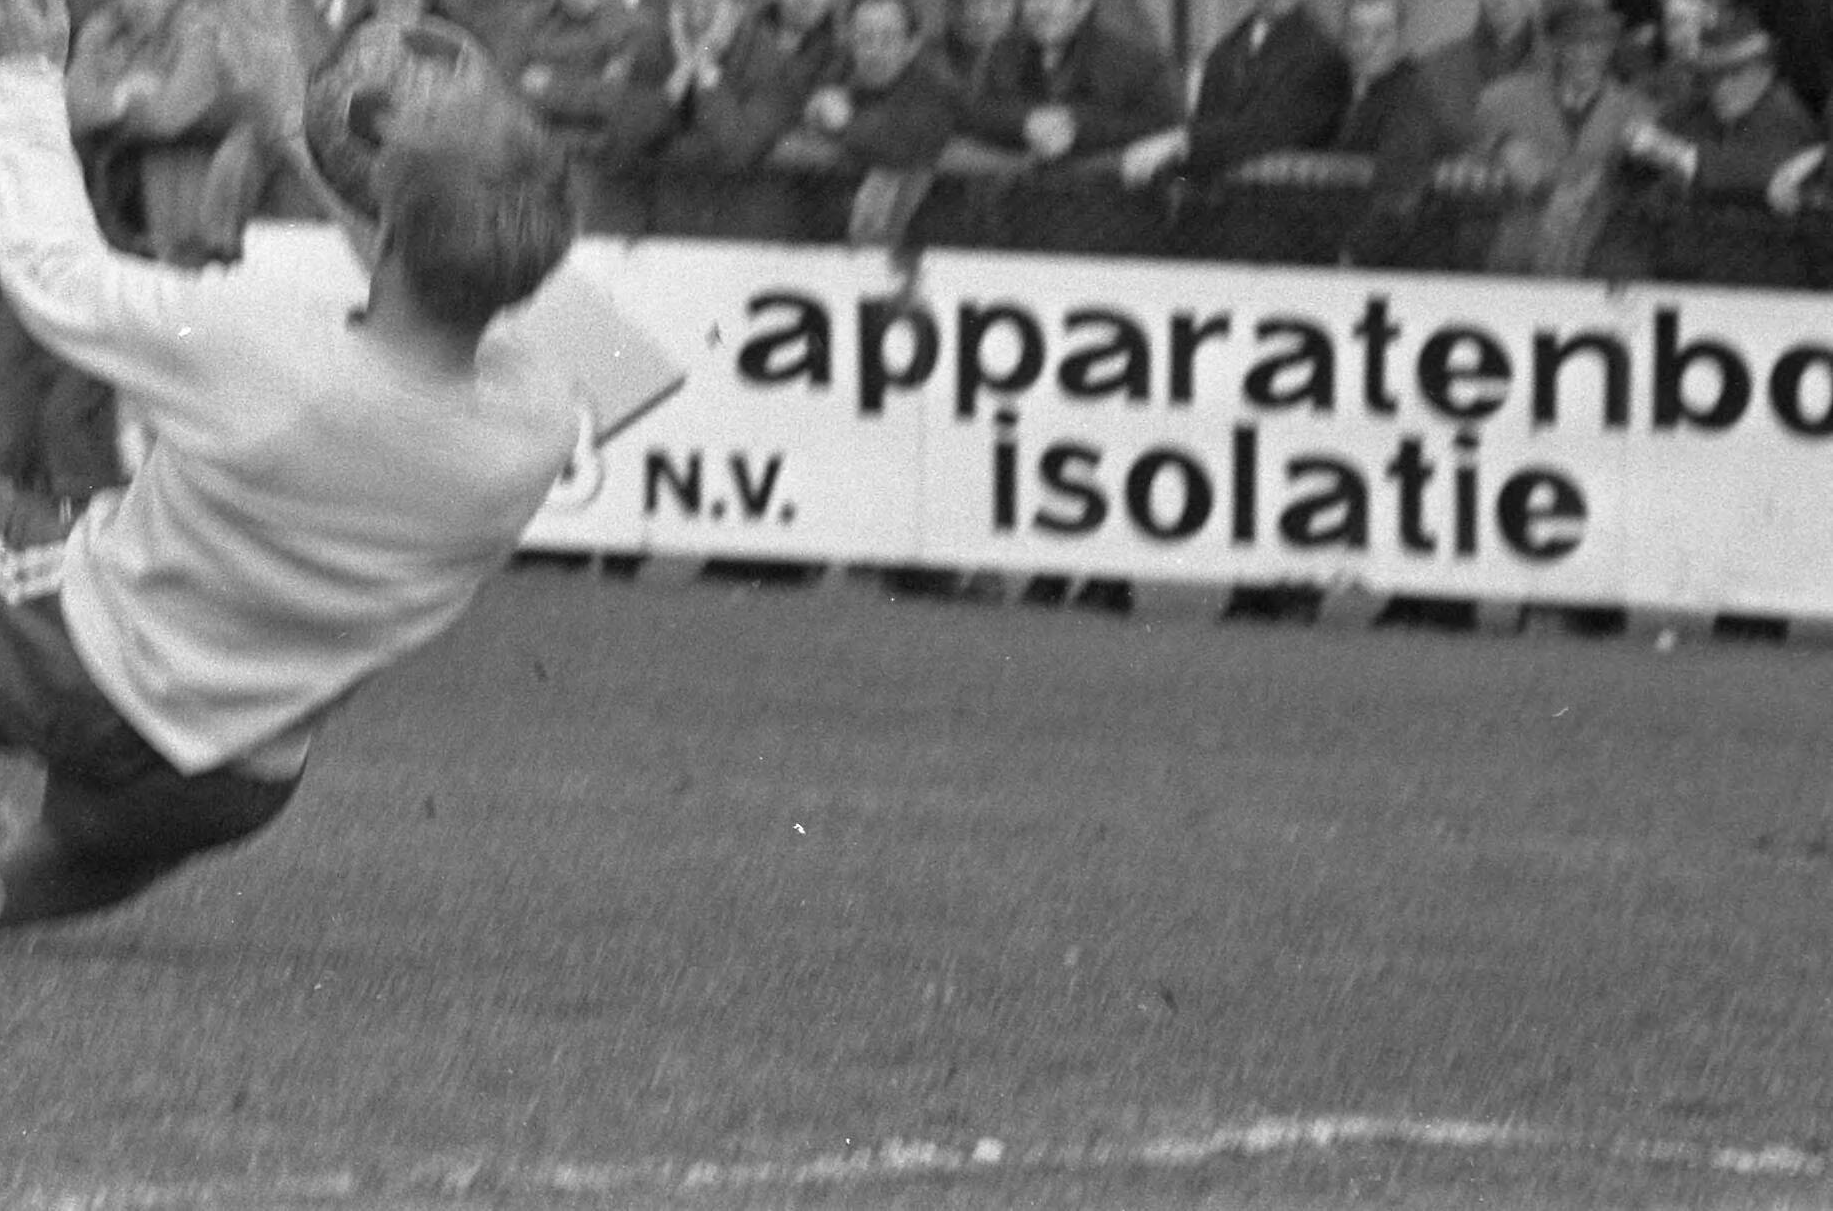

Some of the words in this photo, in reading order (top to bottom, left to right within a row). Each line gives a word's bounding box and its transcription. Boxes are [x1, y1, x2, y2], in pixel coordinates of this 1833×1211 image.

[736, 287, 1833, 440] apparatenbo
[643, 447, 796, 525] N.V.
[989, 407, 1588, 563] isolatie
